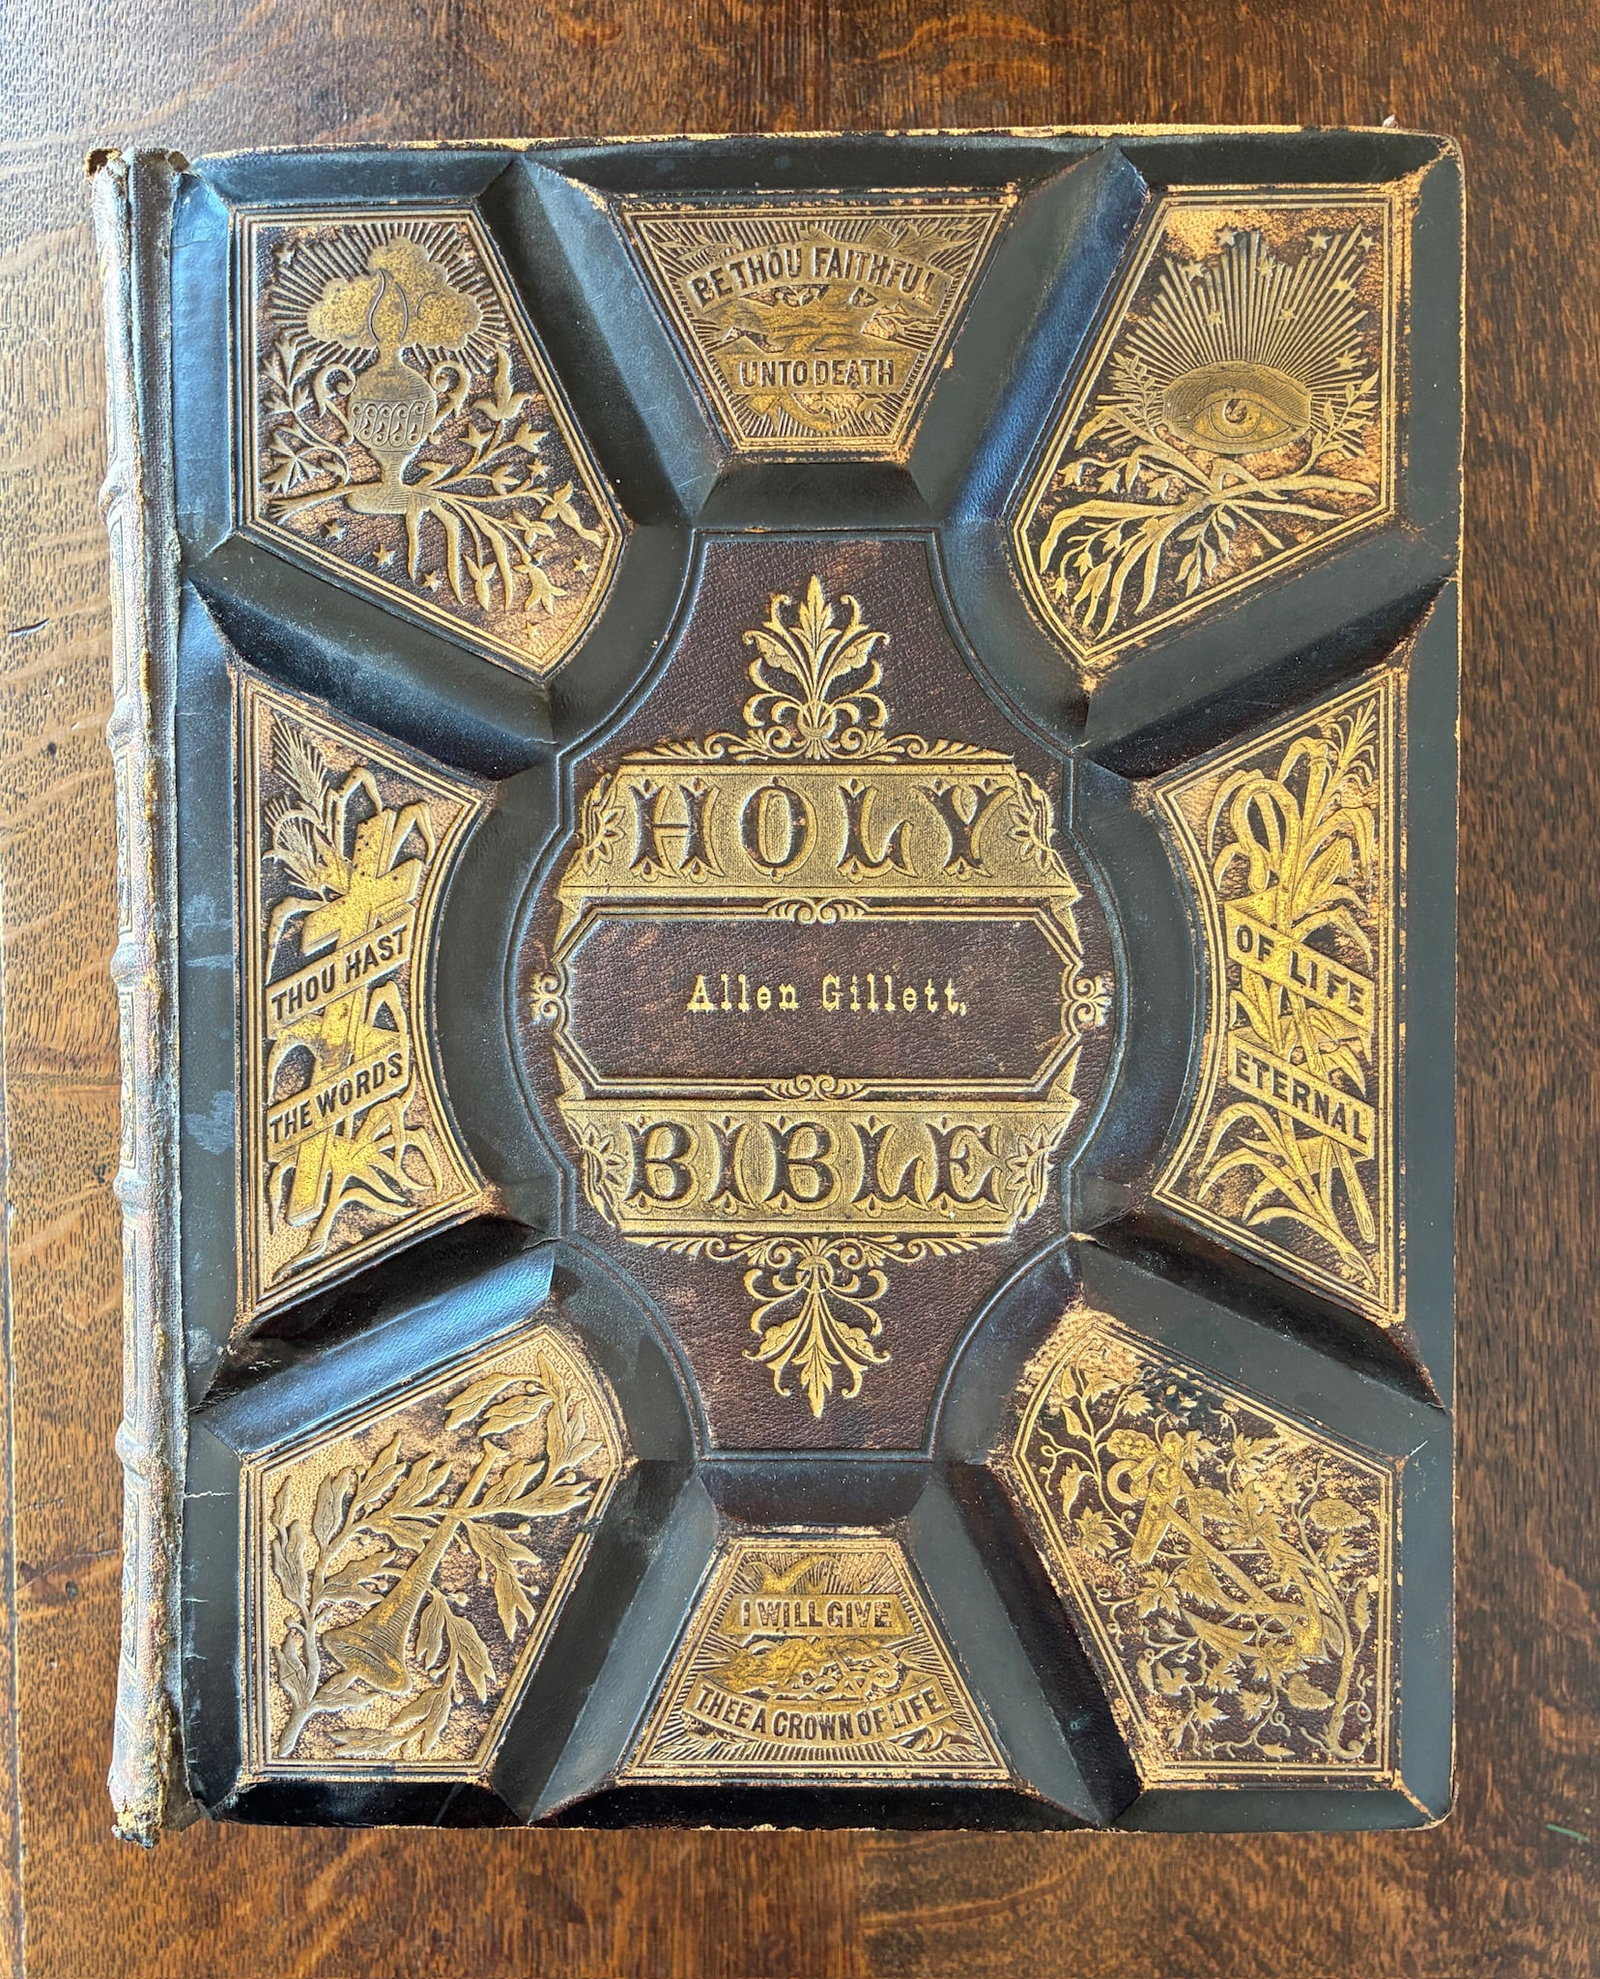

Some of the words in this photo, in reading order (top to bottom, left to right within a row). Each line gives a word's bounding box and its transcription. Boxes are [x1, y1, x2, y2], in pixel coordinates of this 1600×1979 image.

[690, 267, 733, 308] BE
[726, 246, 802, 290] THOU
[812, 246, 936, 306] FAITHFUL
[739, 359, 808, 388] UNTO
[813, 359, 895, 388] DEATH
[628, 777, 1018, 884] HOLY
[271, 962, 336, 1021] THOU
[344, 923, 408, 984] HAST
[685, 974, 800, 1012] Allen
[1235, 924, 1275, 962] OF
[1288, 949, 1365, 1017] LIFE
[268, 1098, 313, 1144] THE
[315, 1051, 402, 1118] WORDS
[1235, 1047, 1368, 1145] ETERNAL
[624, 1114, 1008, 1214] BIBLE
[742, 1600, 751, 1628] I
[757, 1600, 824, 1628] WILL
[826, 1600, 893, 1628] GIVE
[696, 1685, 752, 1732] THEE
[751, 1707, 767, 1735] A
[772, 1710, 852, 1741] CROWN
[856, 1706, 888, 1736] OF
[889, 1687, 947, 1729] LIFE
